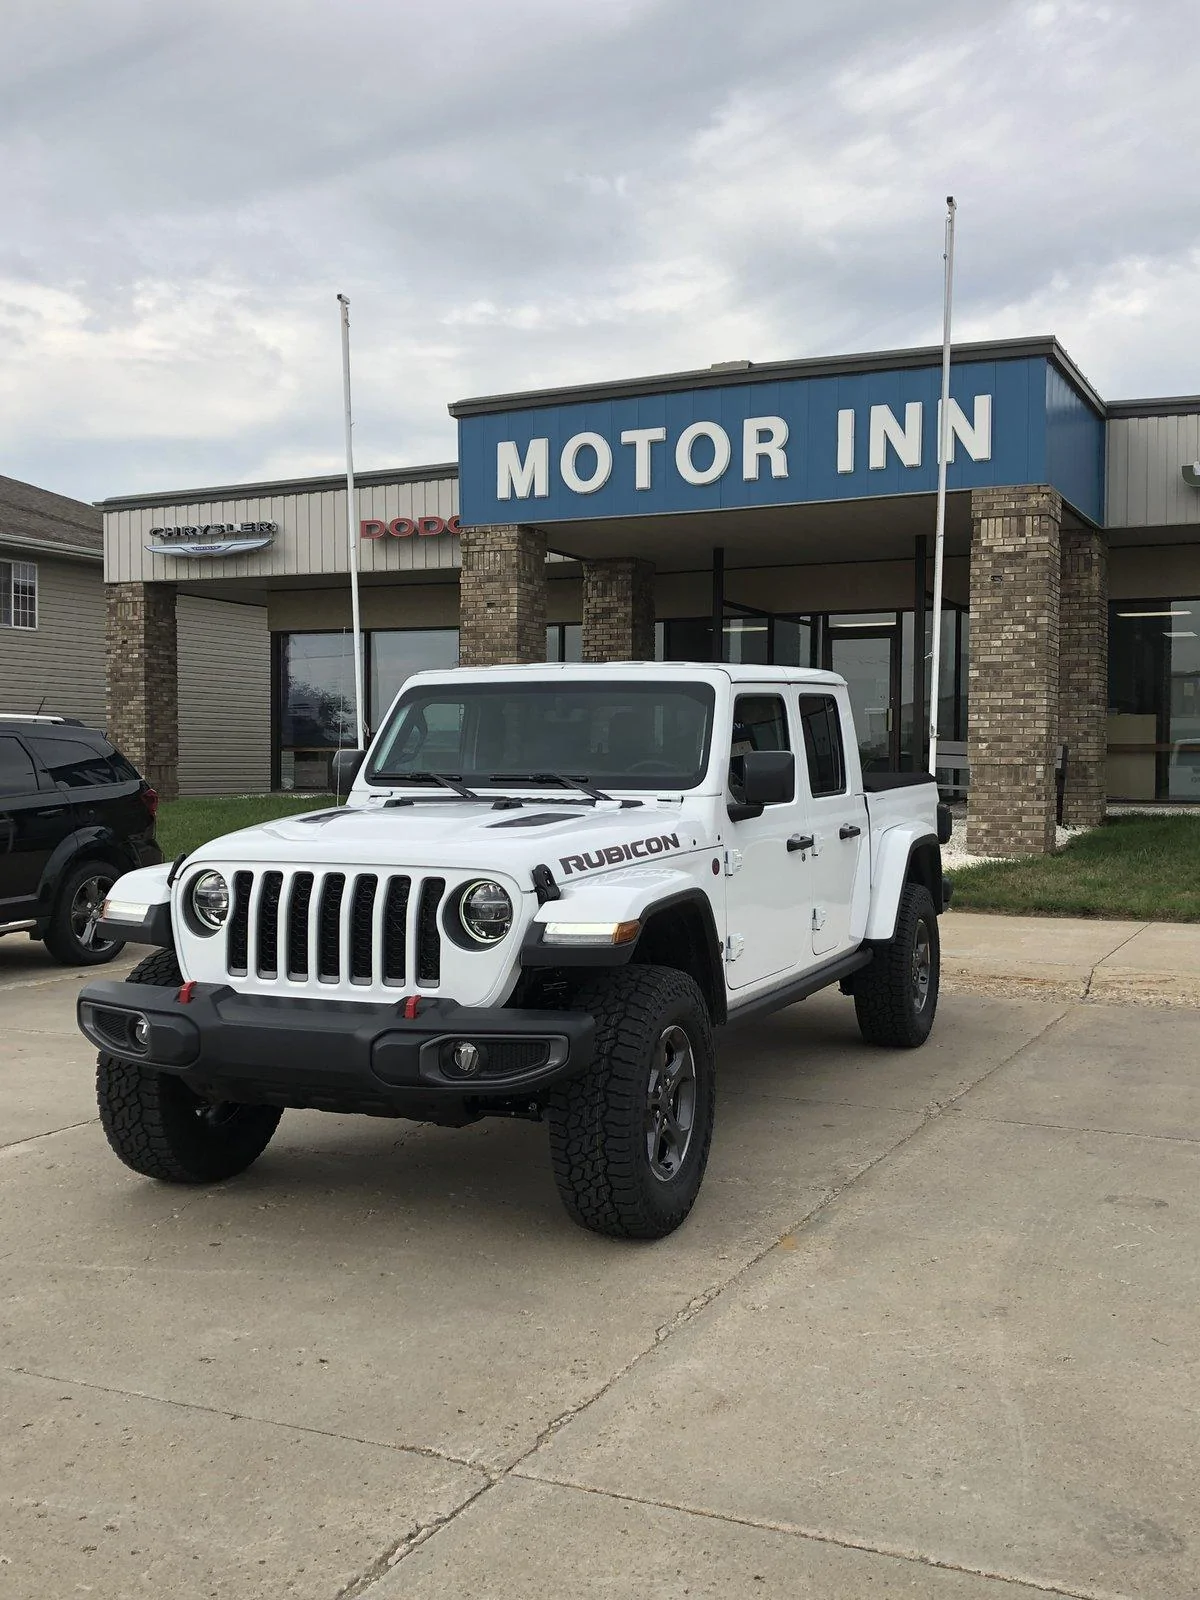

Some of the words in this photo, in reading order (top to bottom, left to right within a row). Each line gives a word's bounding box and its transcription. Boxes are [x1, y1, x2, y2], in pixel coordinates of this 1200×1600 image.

[497, 415, 789, 500] MOTOR
[837, 394, 992, 474] INN
[149, 521, 275, 538] CHRYSLER
[558, 833, 680, 875] RUBICON
